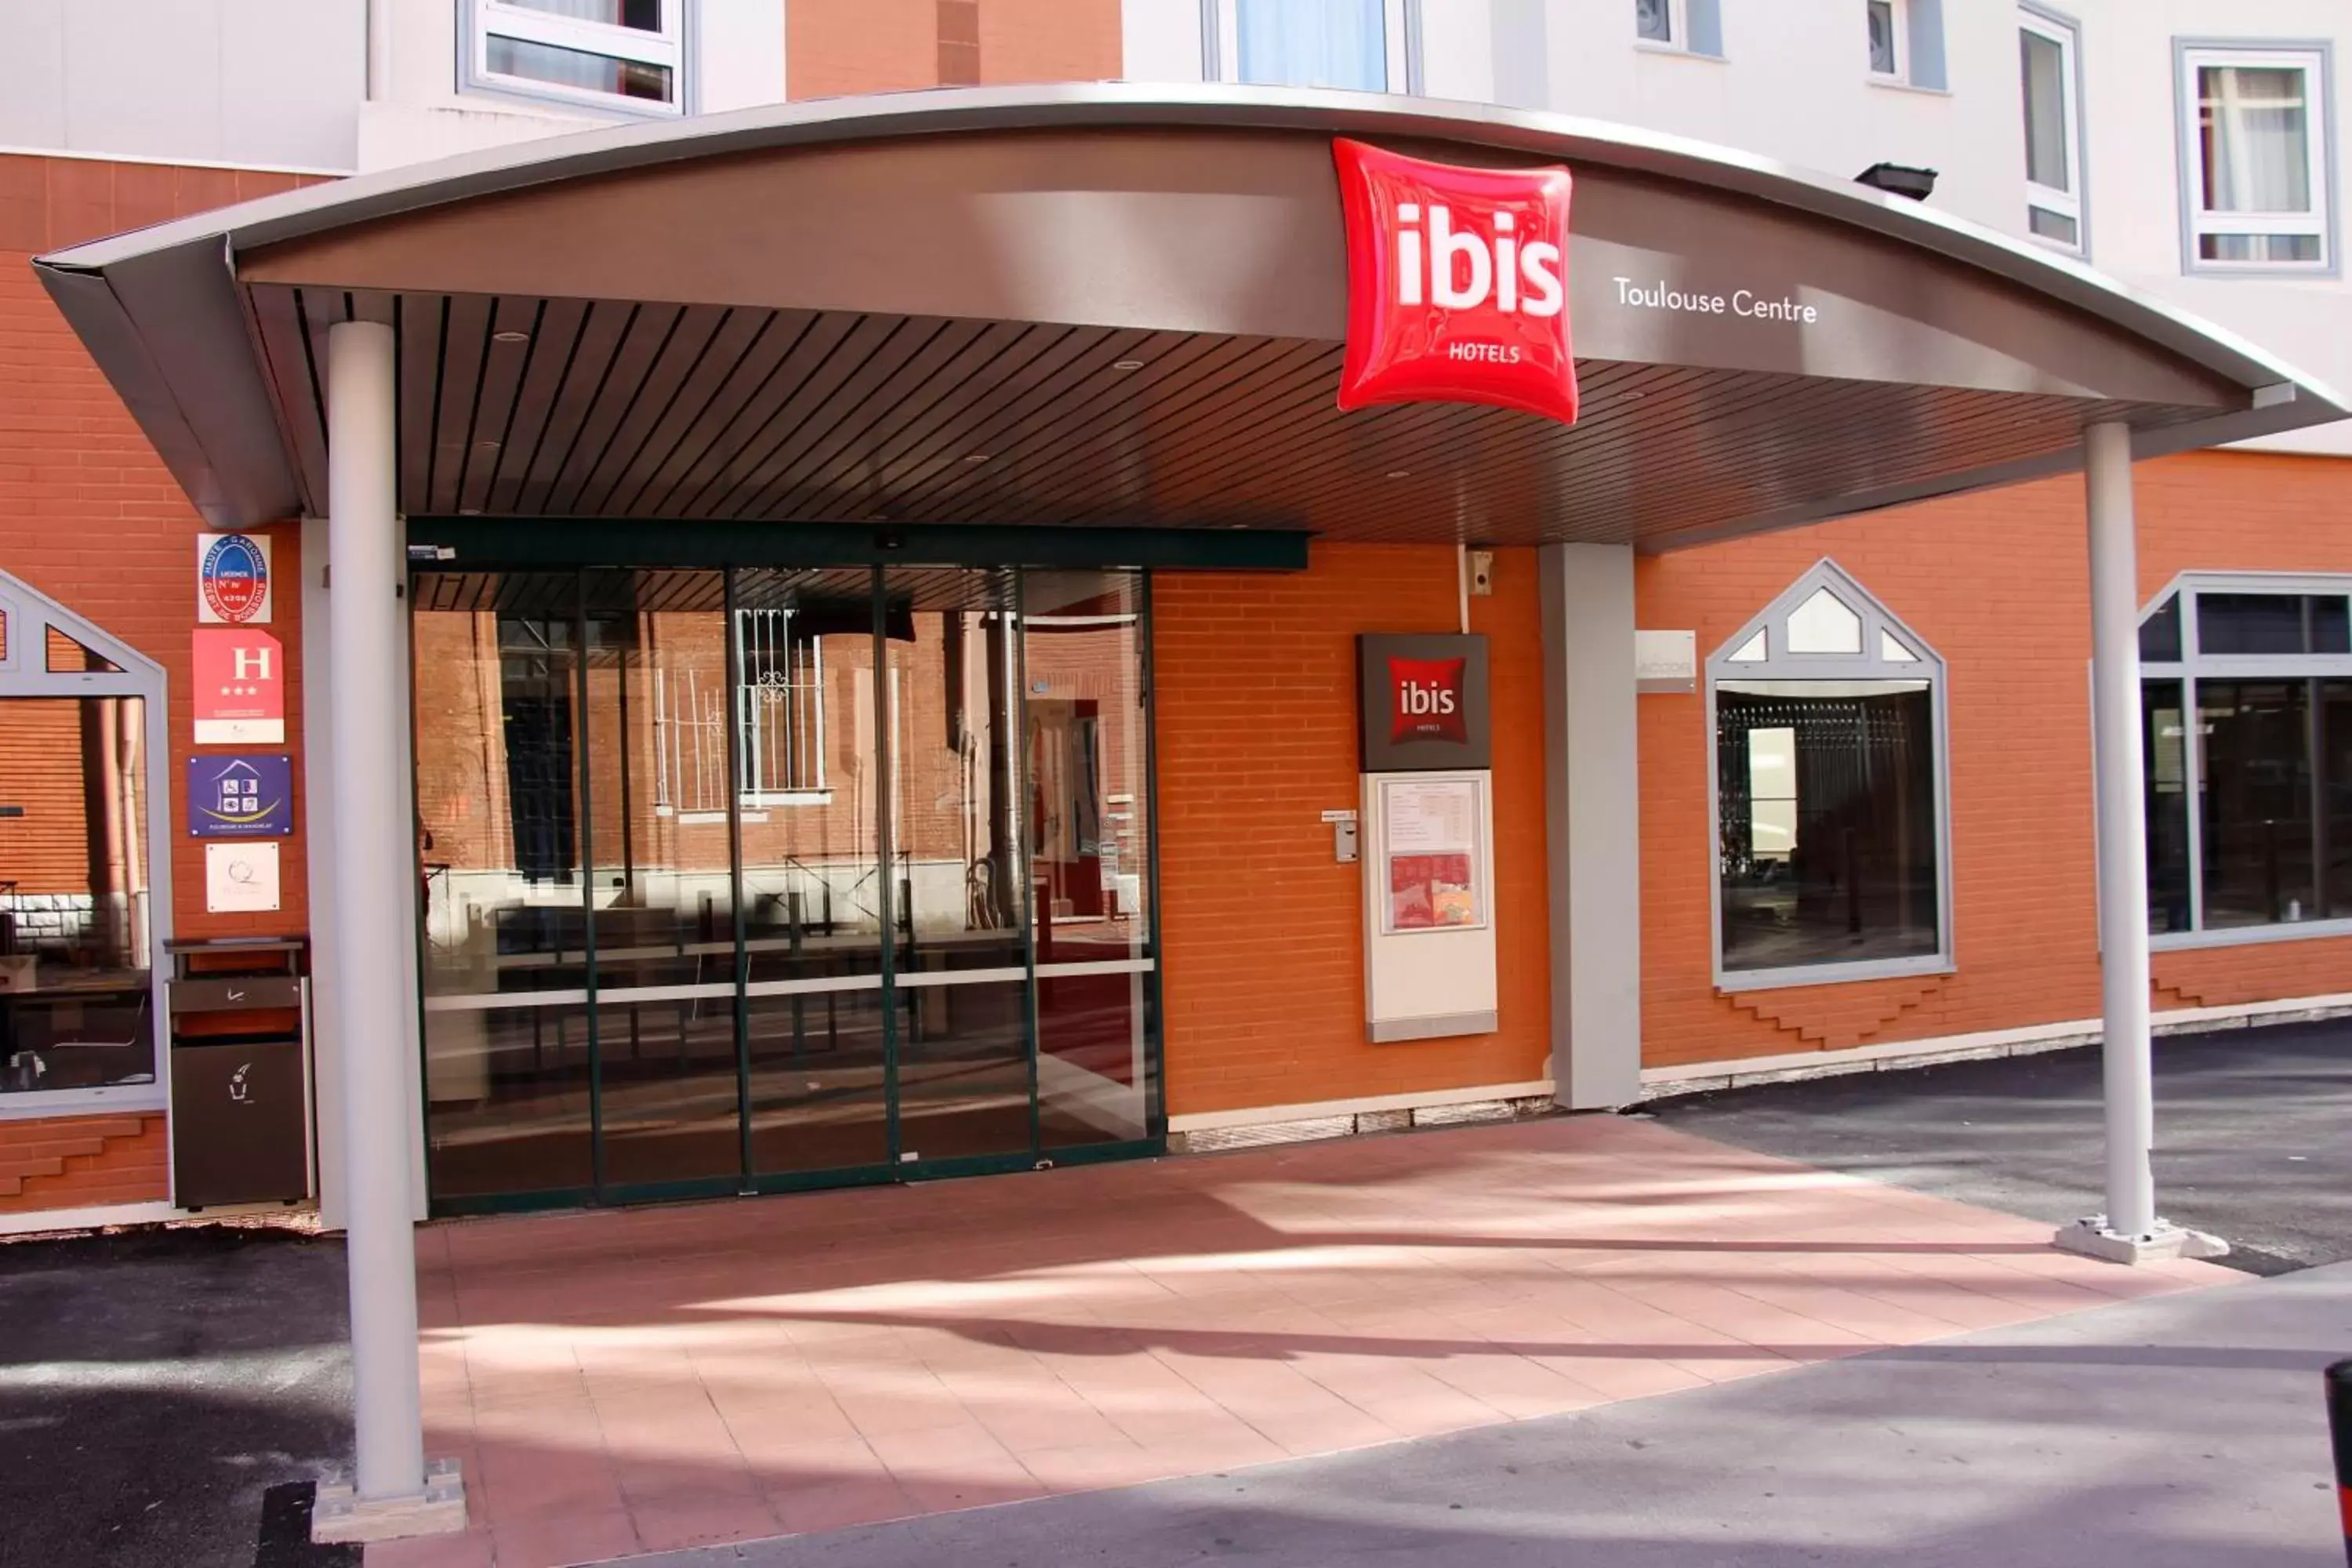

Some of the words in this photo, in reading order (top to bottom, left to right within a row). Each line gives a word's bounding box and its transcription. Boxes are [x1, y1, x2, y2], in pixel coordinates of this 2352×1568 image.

[1396, 202, 1563, 318] ibis
[1613, 275, 1726, 316] Toulouse
[1733, 284, 1818, 325] Centre
[1449, 342, 1520, 365] HOTELS
[234, 648, 273, 680] H
[1401, 681, 1454, 714] ibis
